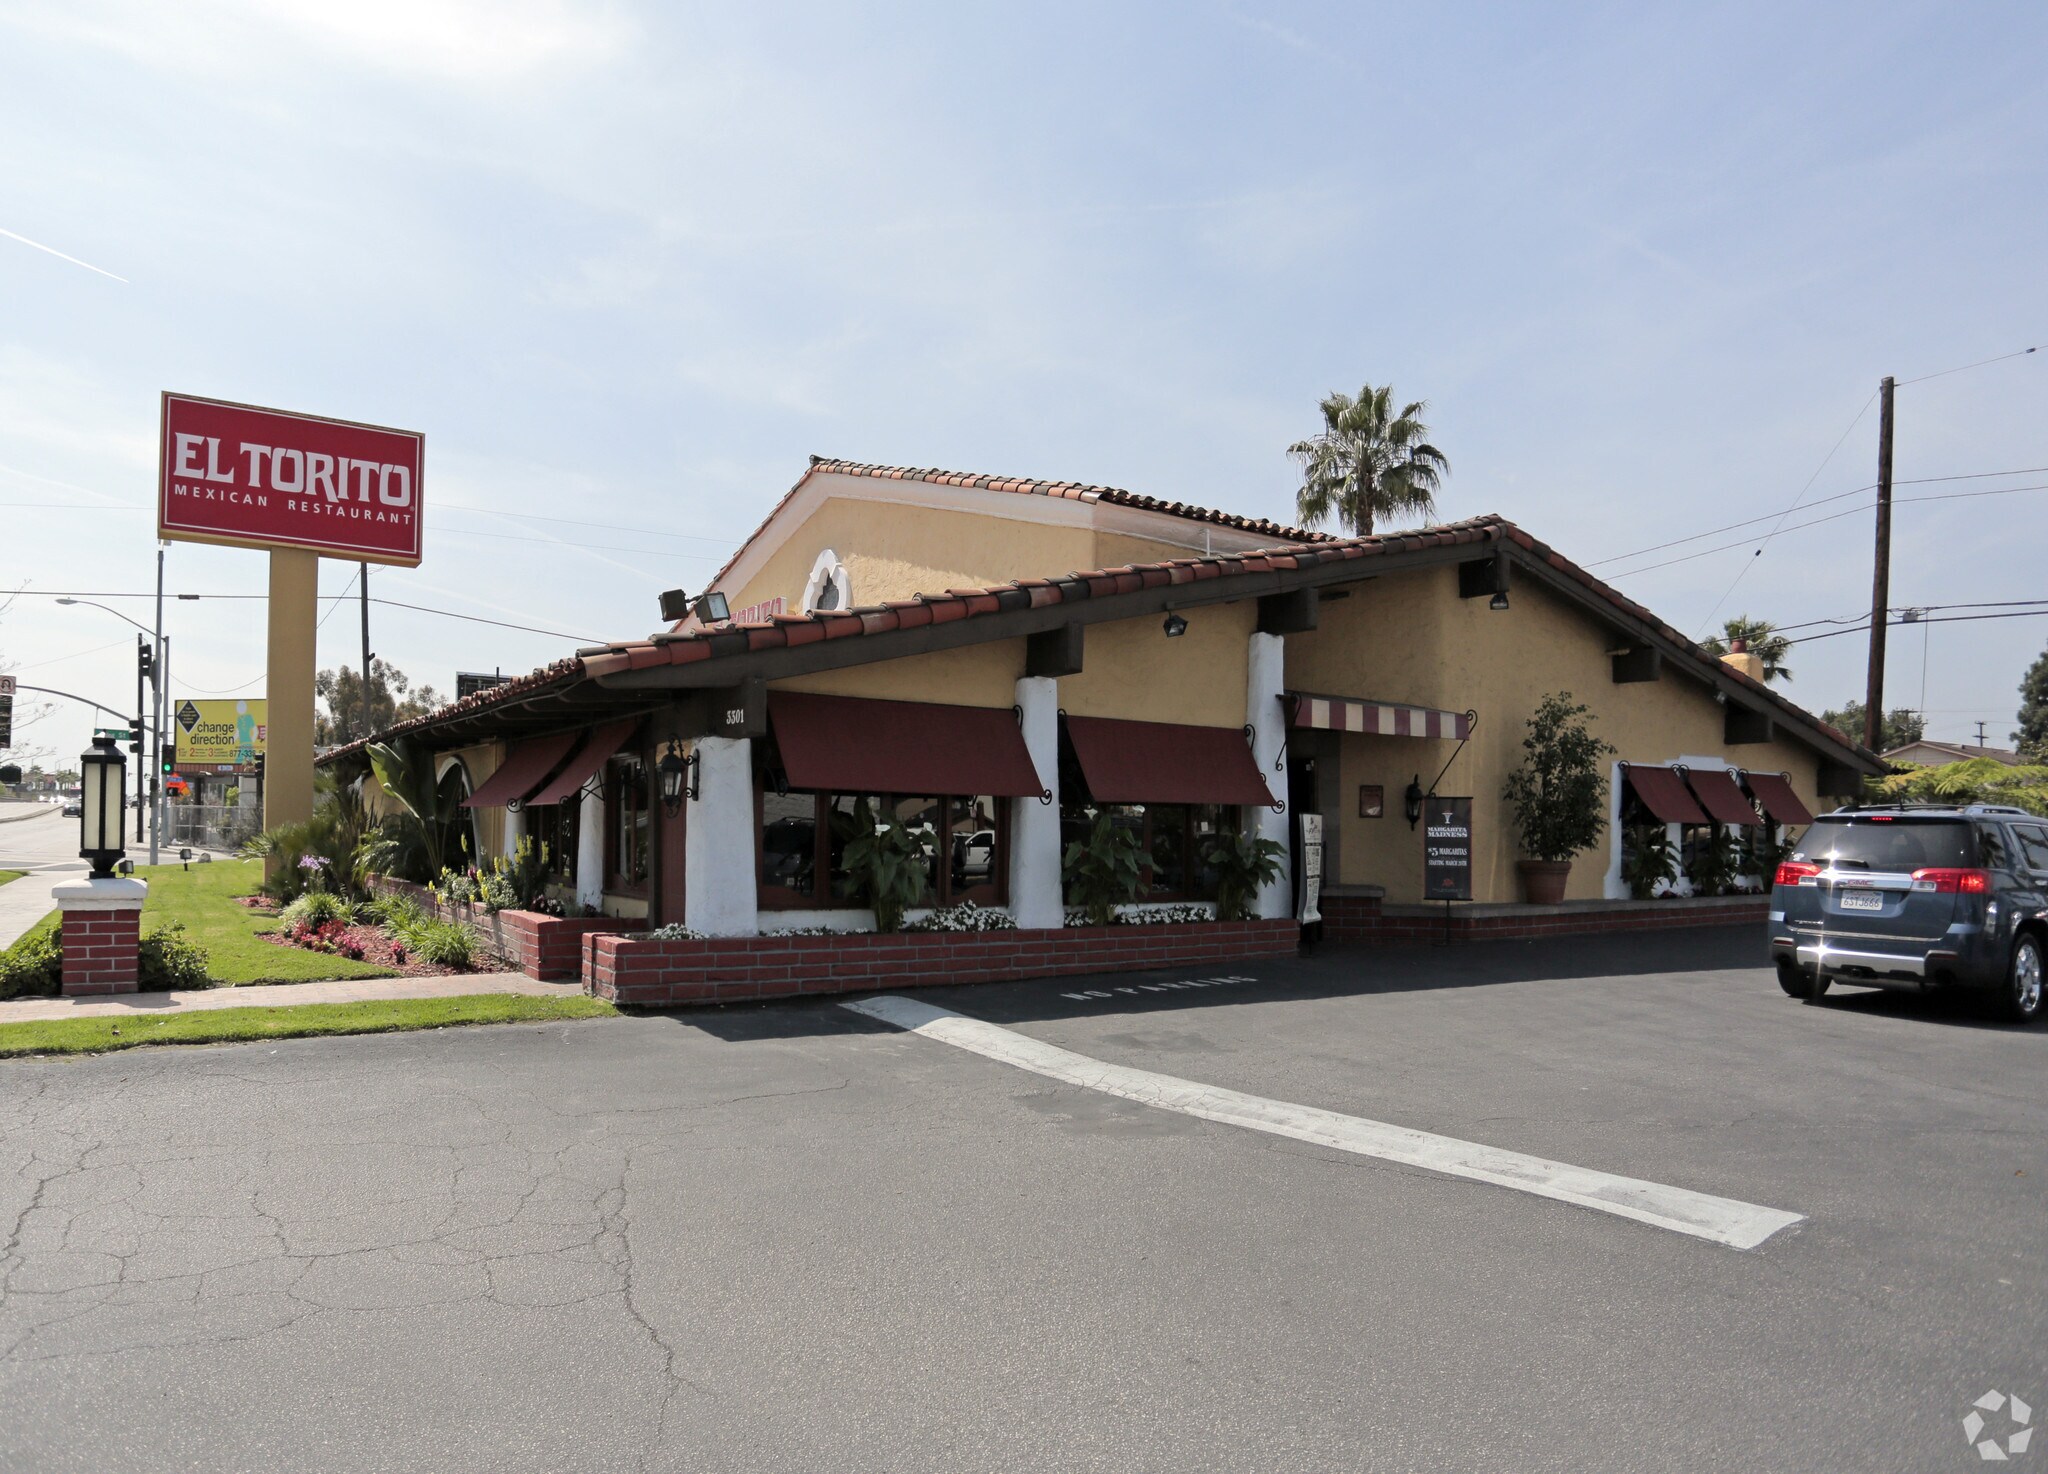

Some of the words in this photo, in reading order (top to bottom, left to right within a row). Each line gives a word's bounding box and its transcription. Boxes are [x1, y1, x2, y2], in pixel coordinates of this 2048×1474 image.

[173, 432, 234, 483] EL
[240, 442, 410, 507] TORITO
[174, 484, 268, 507] MEXICAN
[288, 499, 411, 525] RESTAURANT
[197, 721, 235, 735] change
[190, 733, 235, 745] direction
[189, 747, 196, 758] 2
[208, 747, 214, 758] 3
[1439, 847, 1468, 856] MARGARITAS
[1060, 990, 1112, 1000] NO
[1114, 976, 1258, 994] PARKING
